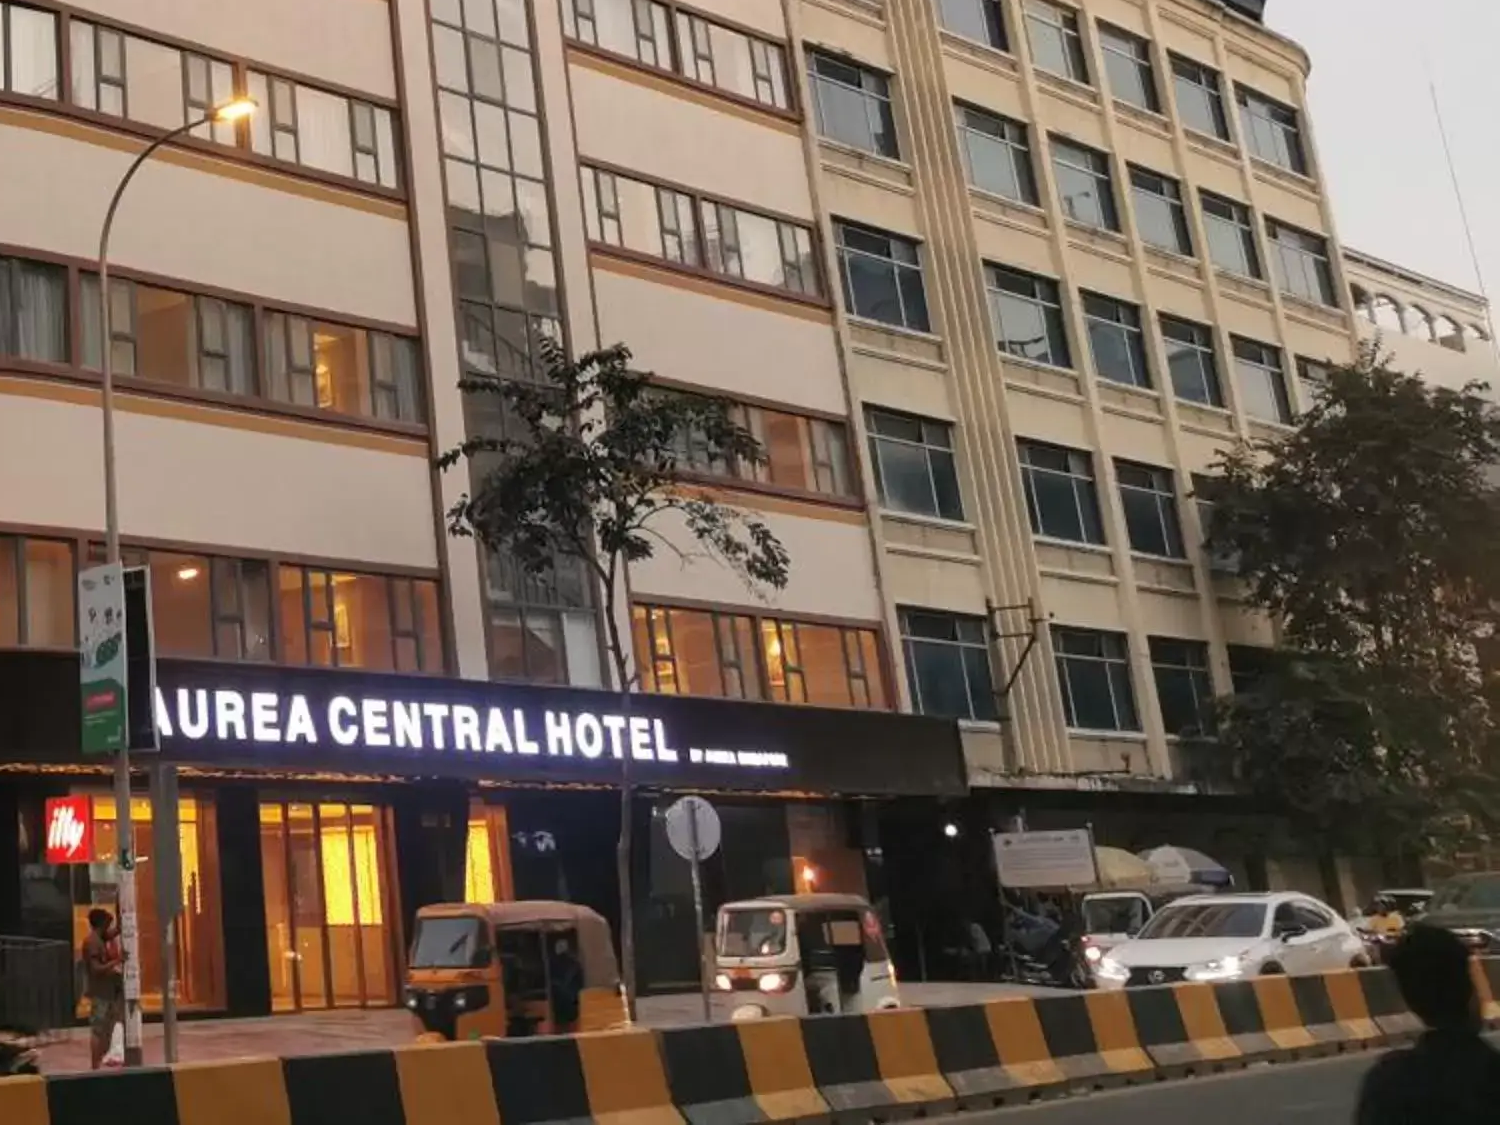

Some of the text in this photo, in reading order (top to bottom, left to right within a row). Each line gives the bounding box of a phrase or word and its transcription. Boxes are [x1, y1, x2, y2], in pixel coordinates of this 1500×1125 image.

[327, 695, 540, 755] CENTRAL
[544, 710, 679, 763] HOTEL
[48, 806, 85, 857] illy
